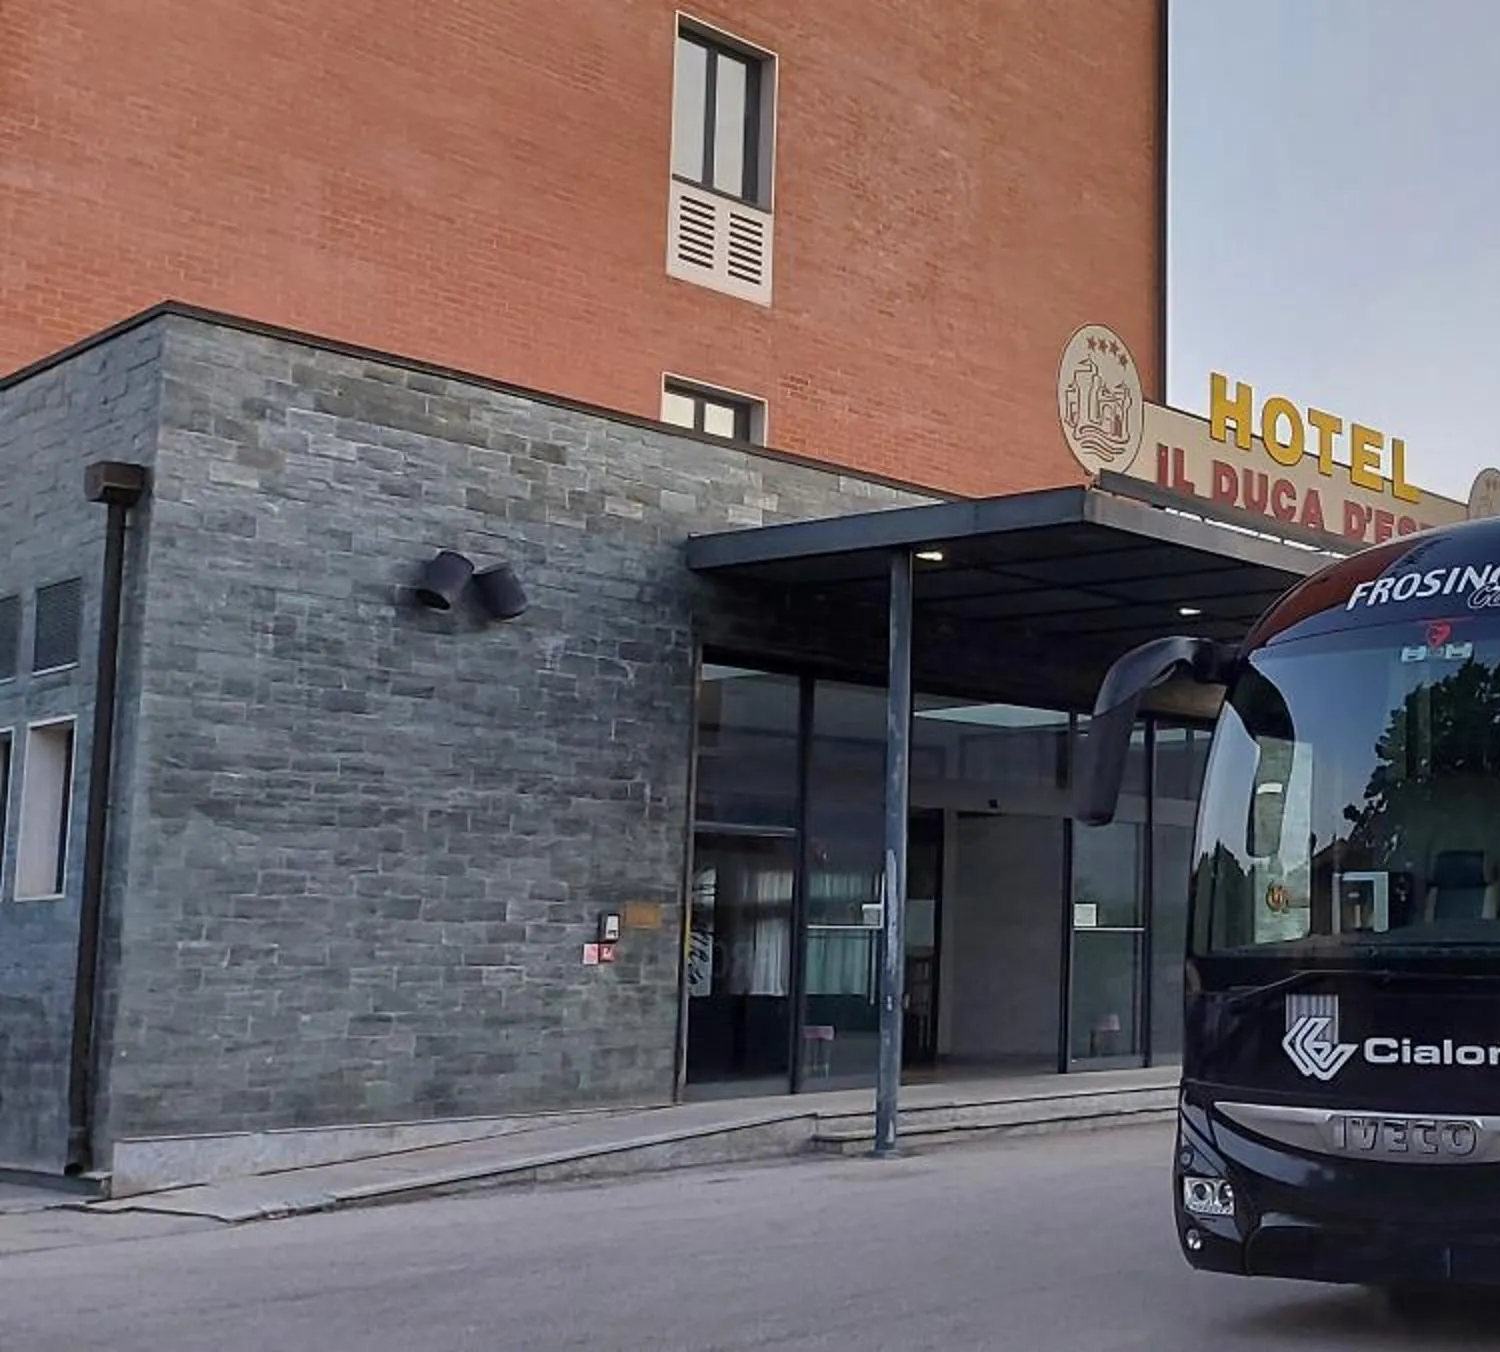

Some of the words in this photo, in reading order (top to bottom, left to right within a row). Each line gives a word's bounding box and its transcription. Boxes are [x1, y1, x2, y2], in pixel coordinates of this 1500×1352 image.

[1210, 372, 1420, 504] HOTEL
[1156, 442, 1195, 497] IL
[1211, 460, 1325, 533] DUCA
[1343, 500, 1434, 545] D'ES
[1333, 1116, 1477, 1157] IVECO
